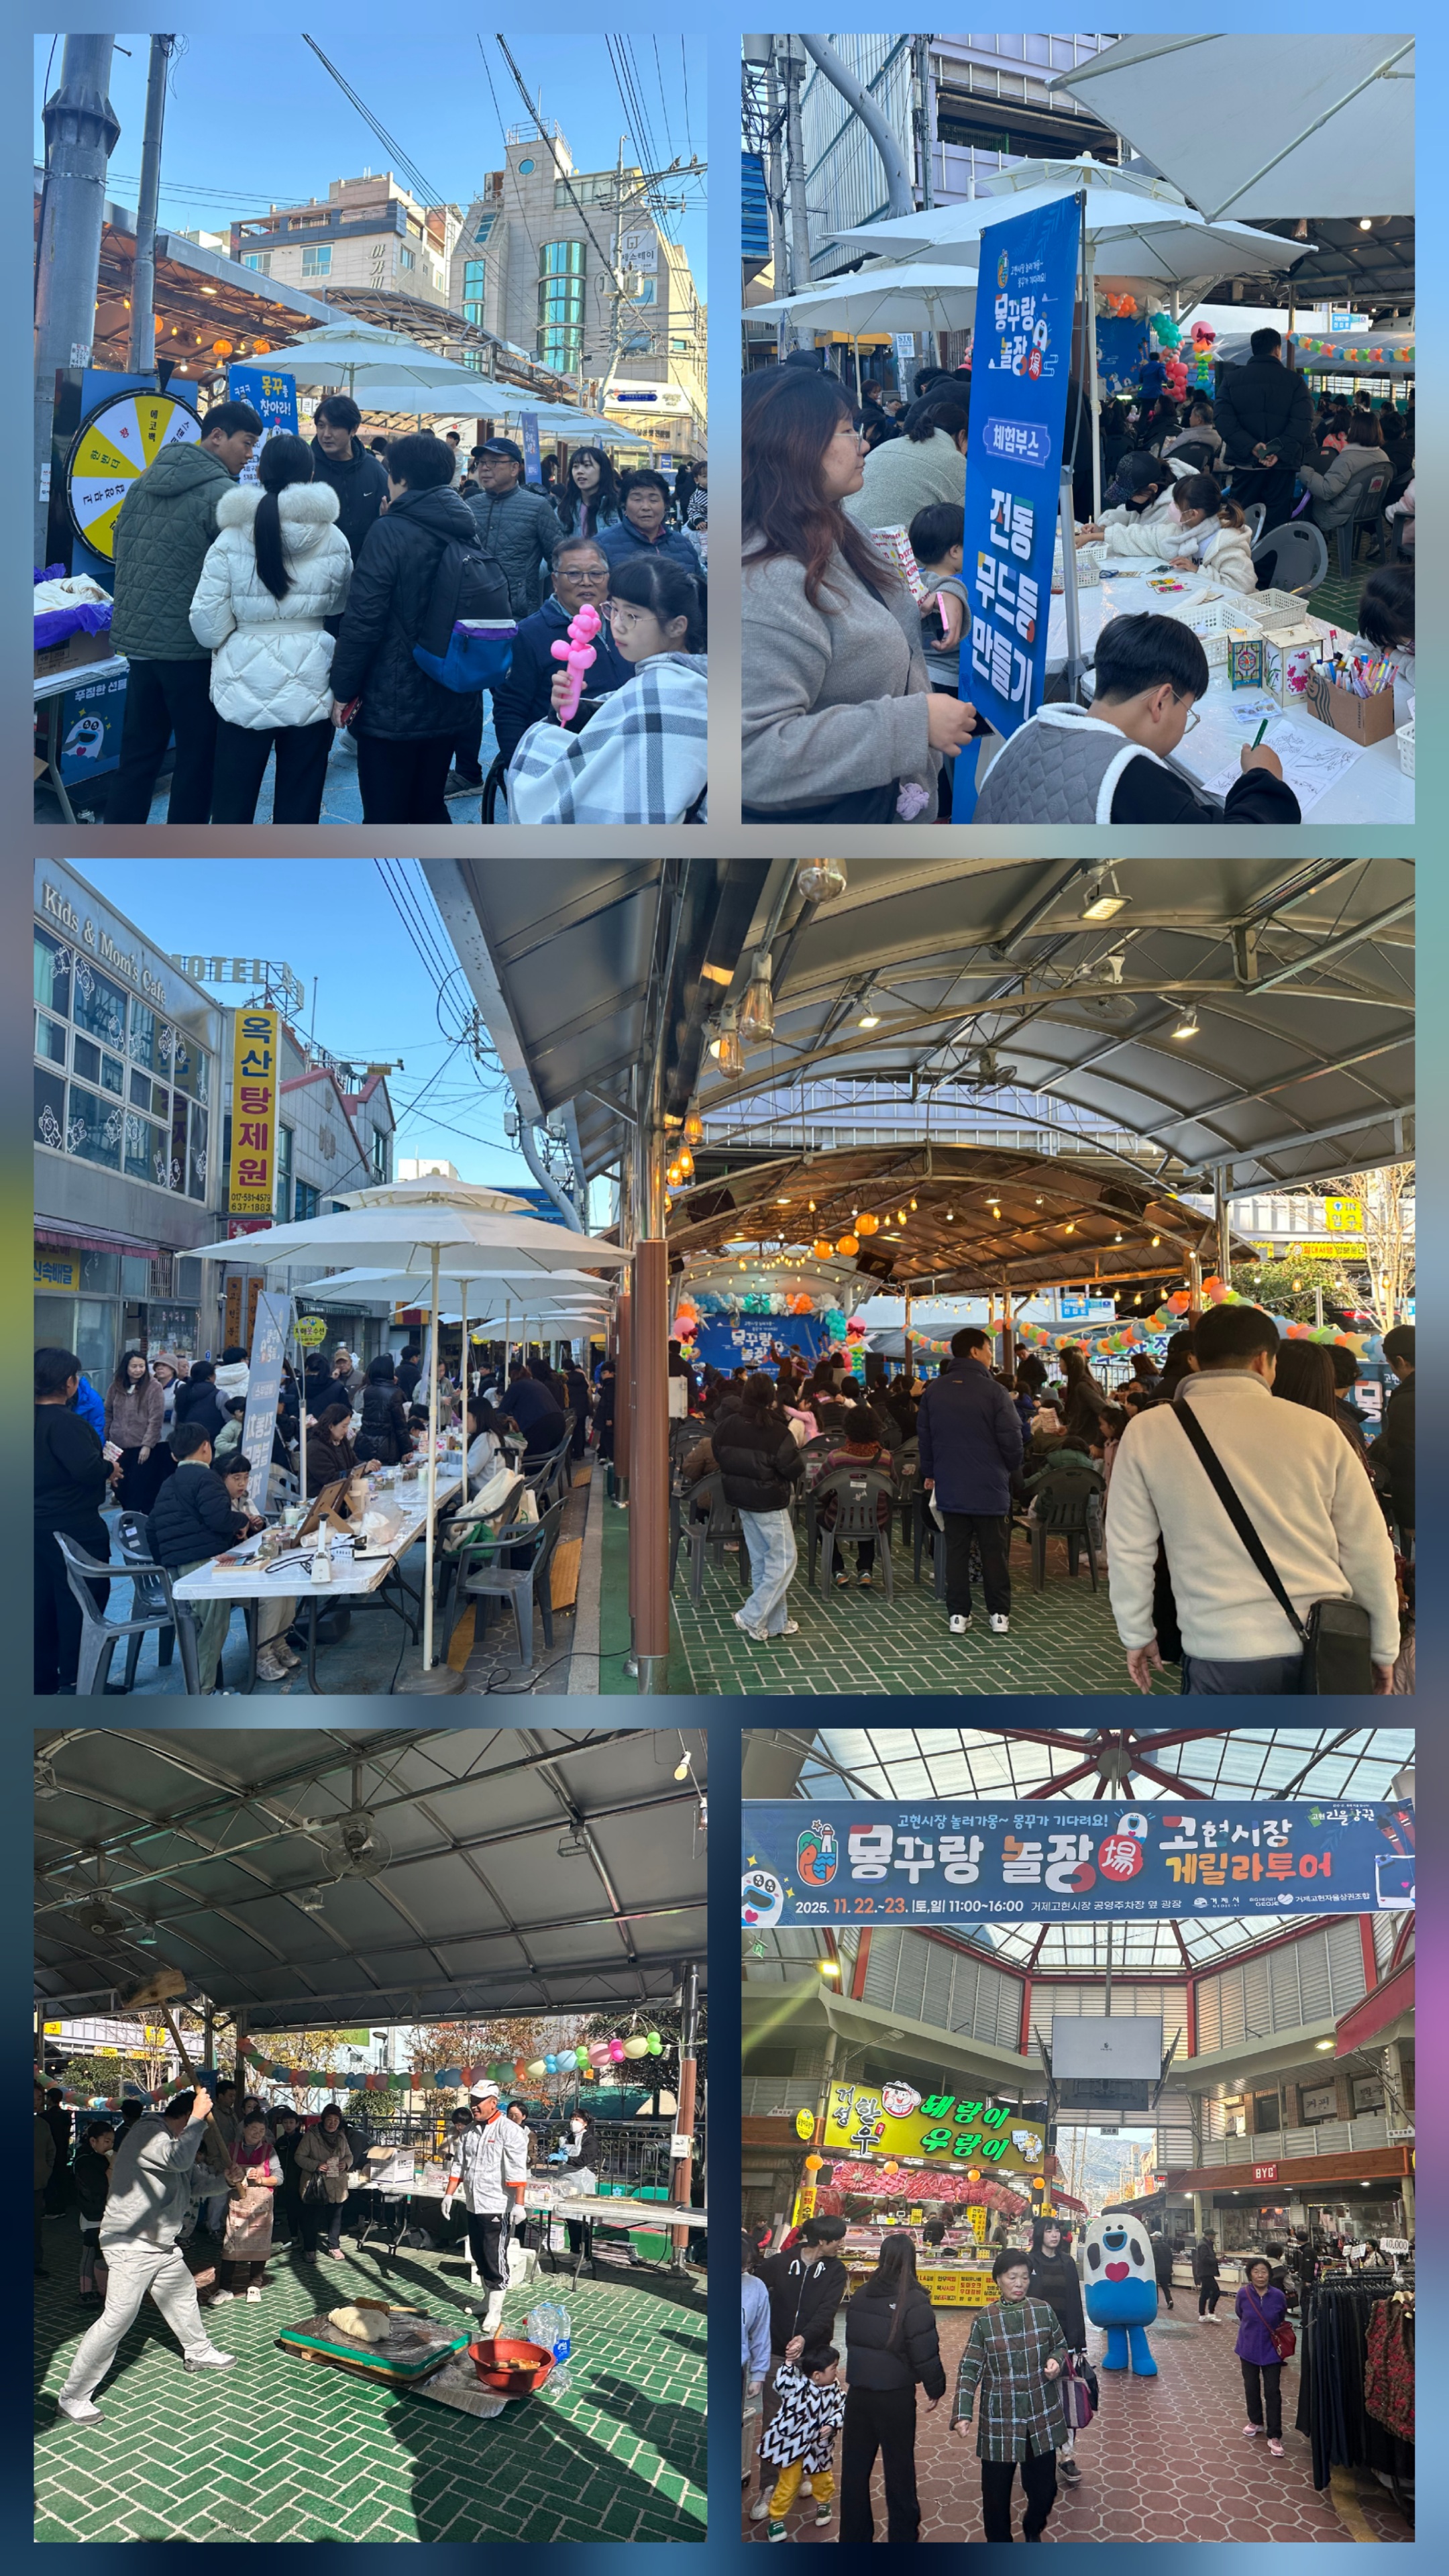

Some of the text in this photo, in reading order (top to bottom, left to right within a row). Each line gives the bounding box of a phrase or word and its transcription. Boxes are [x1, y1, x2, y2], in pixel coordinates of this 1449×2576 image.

[621, 250, 654, 262] 제스테이
[995, 293, 1036, 333] 몽꾸랑
[262, 376, 288, 398] 몽꾸를
[260, 398, 291, 417] 찾아라!
[119, 427, 129, 439] 꽝
[148, 409, 158, 443] 에코백
[993, 424, 1039, 458] 체험부스
[90, 449, 121, 469] 한번더
[83, 484, 125, 505] 고무장갑
[989, 488, 1034, 561] 전통
[975, 550, 1038, 644] 무드등
[971, 614, 1033, 721] 만들기
[74, 678, 127, 702] 푸짐한 선물
[43, 883, 166, 1005] Kids & Mom's Cafe
[237, 1016, 273, 1187] 옥산탕제원
[231, 1193, 271, 1202] 017-581-4579
[231, 1203, 271, 1212] 637-1883
[731, 1329, 773, 1346] 몽꾸랑
[898, 1814, 1108, 1830] 고현시장 놀러가몽~ 몽꾸가 기다려요!
[1159, 1816, 1293, 1850] 고현시장
[847, 1824, 1096, 1894] 몽꾸랑 놀장
[1165, 1851, 1332, 1886] 게릴라투어
[795, 1901, 830, 1914] 2025.
[833, 1898, 851, 1913] 11.
[949, 1900, 1024, 1912] 11:00~16:00
[1031, 1901, 1091, 1911] 거제고현시장
[1093, 1900, 1146, 1911] 공영주차장
[1148, 1899, 1159, 1911] 옆
[1161, 1899, 1182, 1910] 광장
[1295, 1892, 1371, 1903] 거제고현자율상권조합
[833, 2085, 855, 2127] 거성
[919, 2094, 1012, 2130] 돼랑이
[1306, 2096, 1330, 2108] 커피
[851, 2096, 883, 2156] 한우
[920, 2127, 1011, 2161] 우랑이
[1256, 2167, 1273, 2178] BYC
